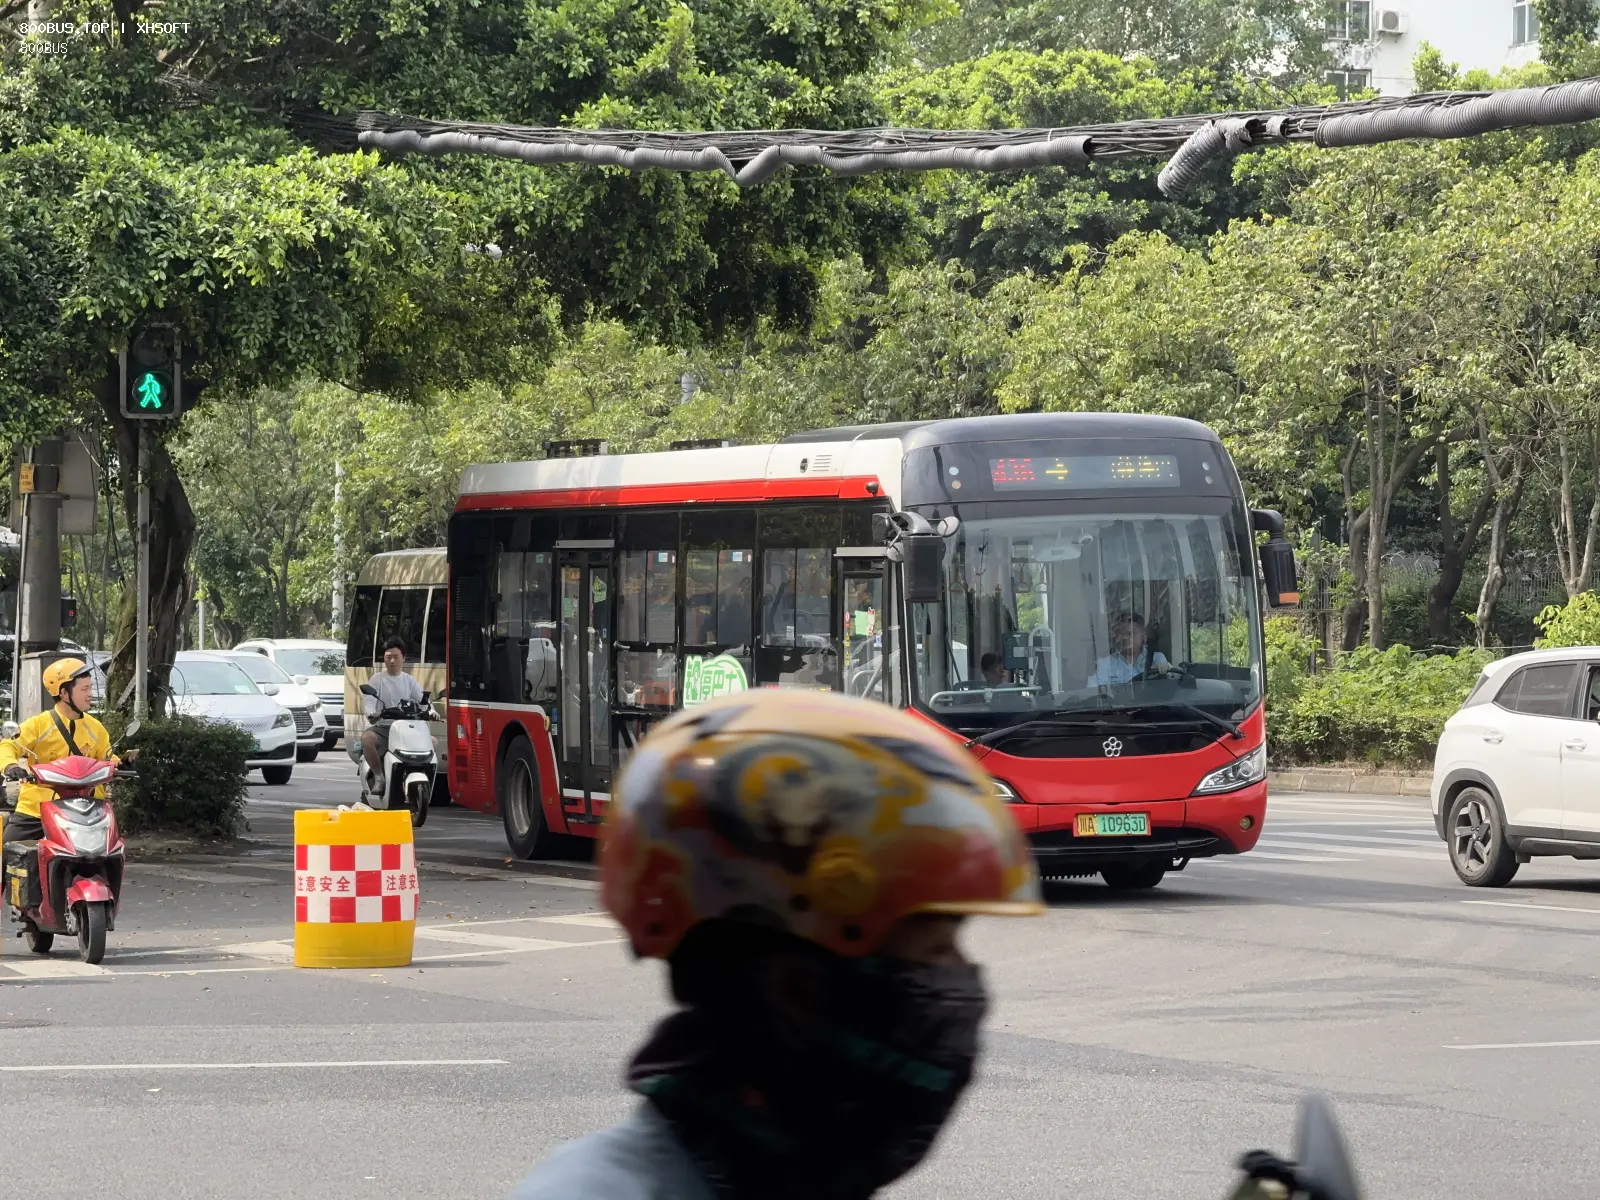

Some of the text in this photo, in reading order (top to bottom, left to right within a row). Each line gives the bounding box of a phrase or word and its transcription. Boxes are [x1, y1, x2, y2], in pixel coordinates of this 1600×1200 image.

[297, 875, 351, 892] 注意安全
[386, 873, 419, 891] 注意安
